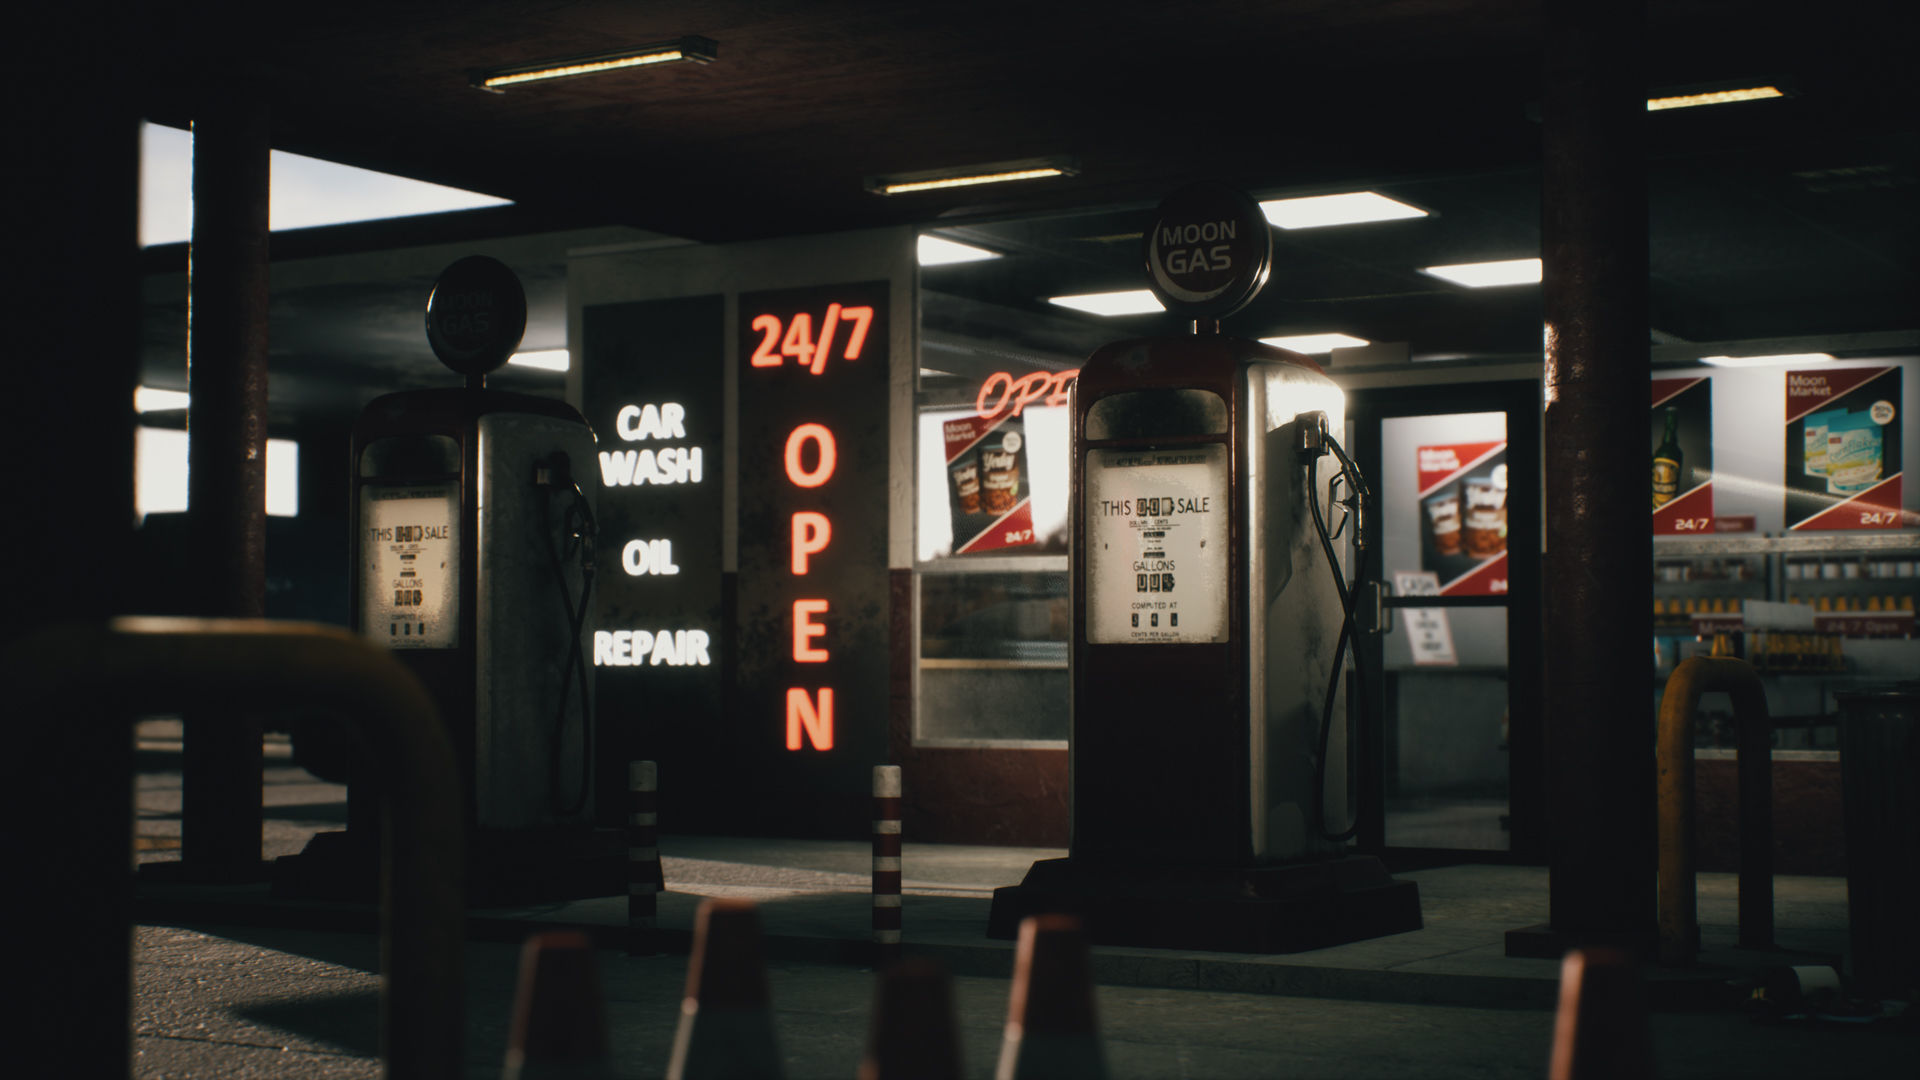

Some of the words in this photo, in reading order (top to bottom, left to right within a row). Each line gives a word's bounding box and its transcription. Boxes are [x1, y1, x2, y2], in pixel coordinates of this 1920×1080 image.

[1162, 220, 1237, 247] MOON
[1166, 244, 1232, 274] GAS
[751, 303, 873, 375] 24/7
[1789, 375, 1827, 387] Moon
[1789, 385, 1832, 397] Market
[616, 402, 686, 441] CAR
[598, 446, 703, 487] WASH
[1101, 500, 1132, 516] THIS
[1177, 497, 1210, 514] SALE
[1675, 518, 1709, 530] 24/7
[1860, 512, 1897, 525] 24/7
[370, 527, 393, 542] THIS
[425, 525, 448, 540] SALE
[1005, 529, 1032, 543] 24/7
[622, 539, 680, 576] OIL
[1133, 560, 1176, 572] GALLONS
[392, 578, 423, 589] GALLONS
[1131, 602, 1167, 610] COMPUTED
[1169, 601, 1178, 609] AT
[1827, 620, 1862, 632] 247
[594, 630, 711, 667] REPAIR
